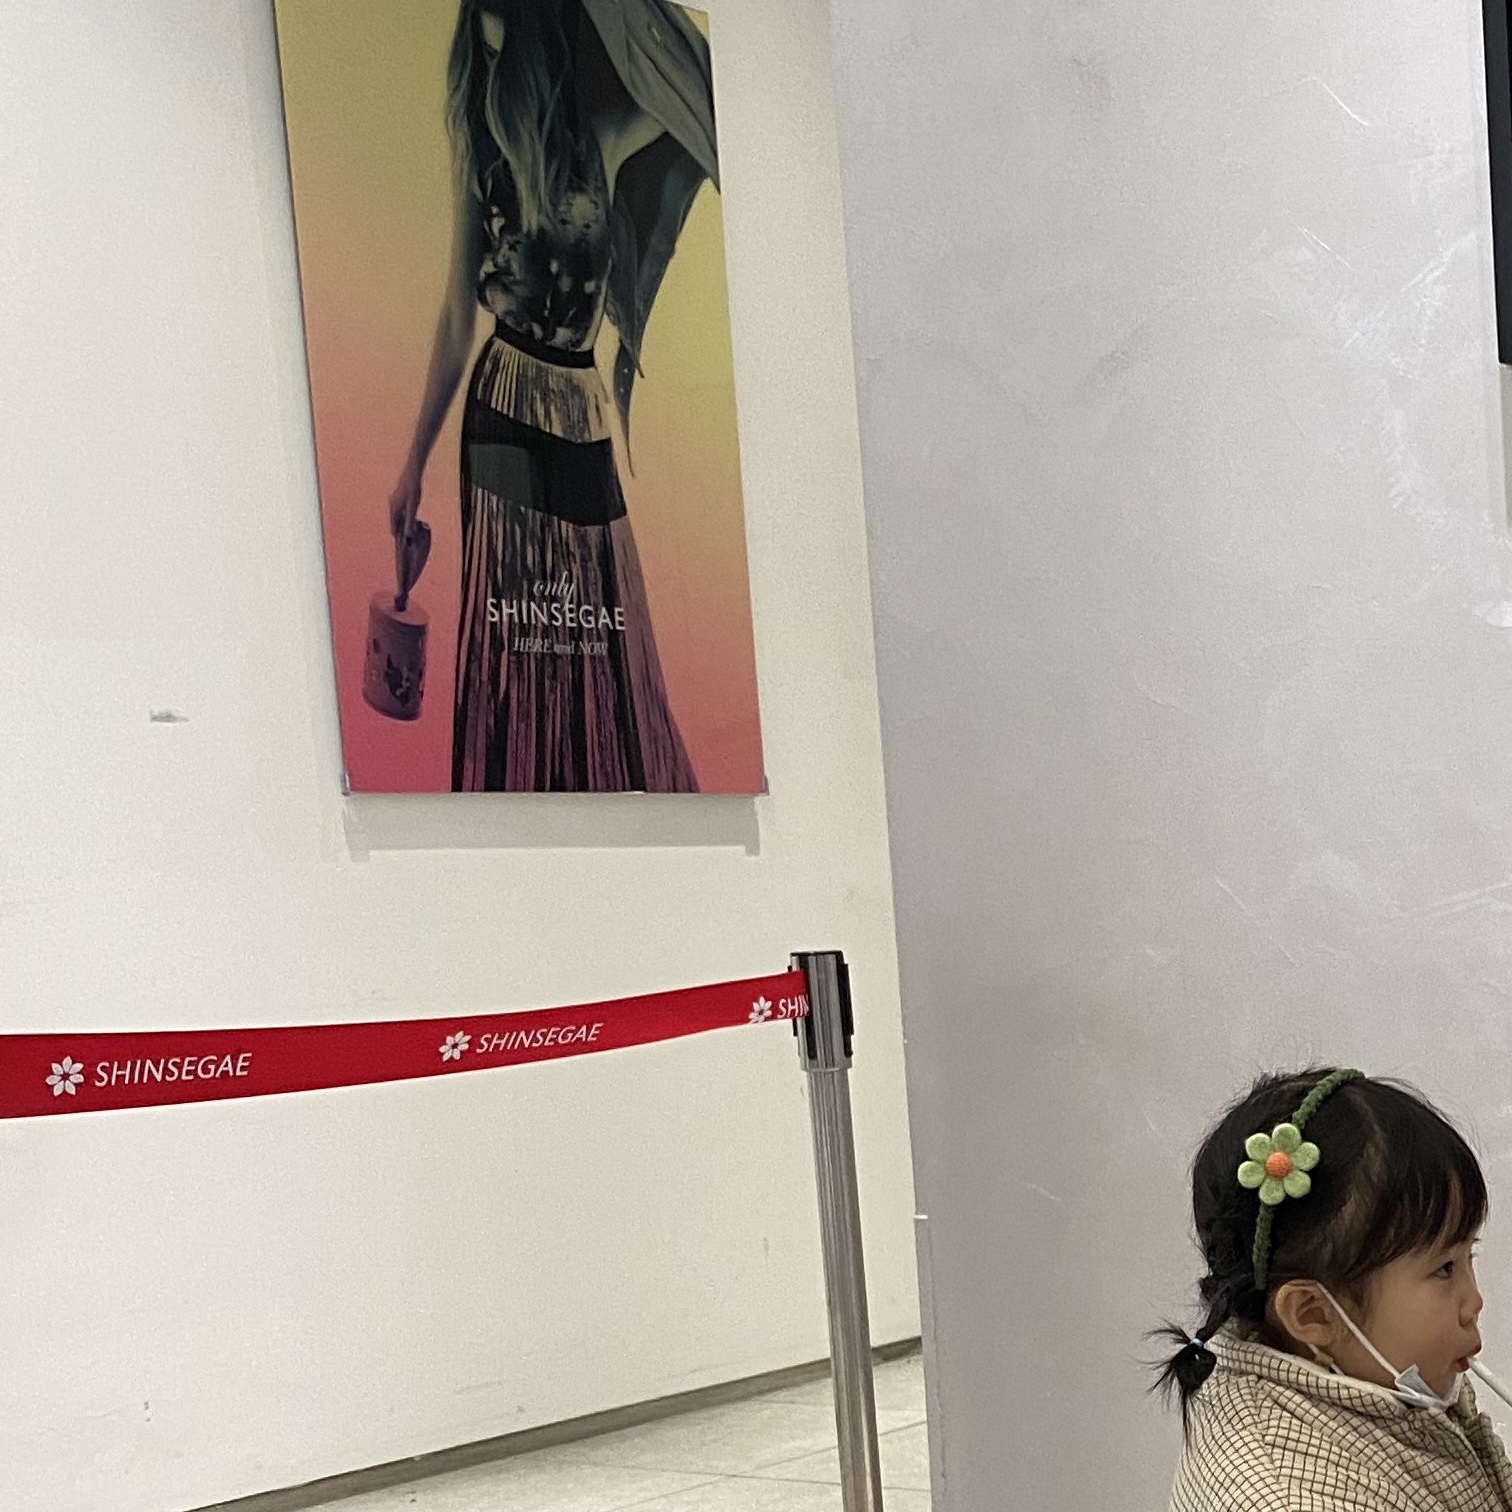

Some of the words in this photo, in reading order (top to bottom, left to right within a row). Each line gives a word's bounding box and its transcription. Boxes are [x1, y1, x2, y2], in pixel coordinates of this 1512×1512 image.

[487, 598, 626, 631] SHINSEGAE
[476, 1022, 604, 1054] SHINSEGAE
[94, 1052, 253, 1087] SHINSEGAE
